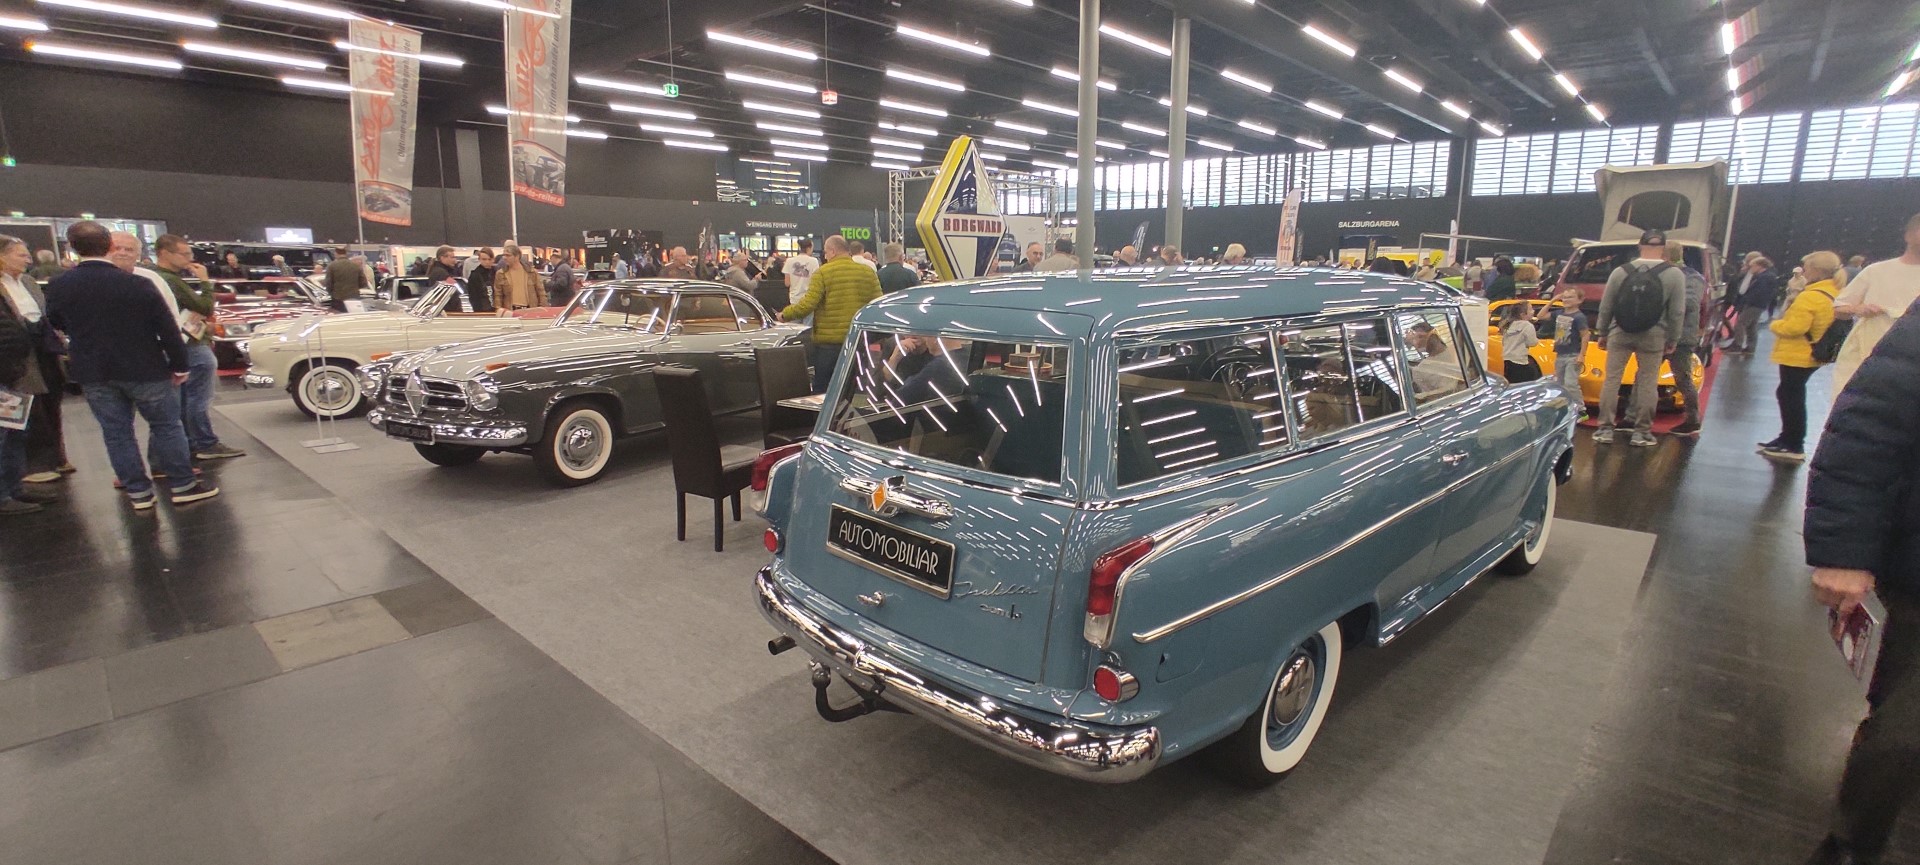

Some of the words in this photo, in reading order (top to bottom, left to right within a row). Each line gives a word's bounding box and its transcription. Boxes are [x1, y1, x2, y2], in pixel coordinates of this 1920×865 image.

[400, 38, 411, 108] Sportwagenhdel
[943, 218, 1001, 233] BORGWARD
[1338, 220, 1399, 228] SALZBURGARENA
[841, 227, 870, 239] TEICO
[839, 520, 938, 575] AUTOMOBILIAR
